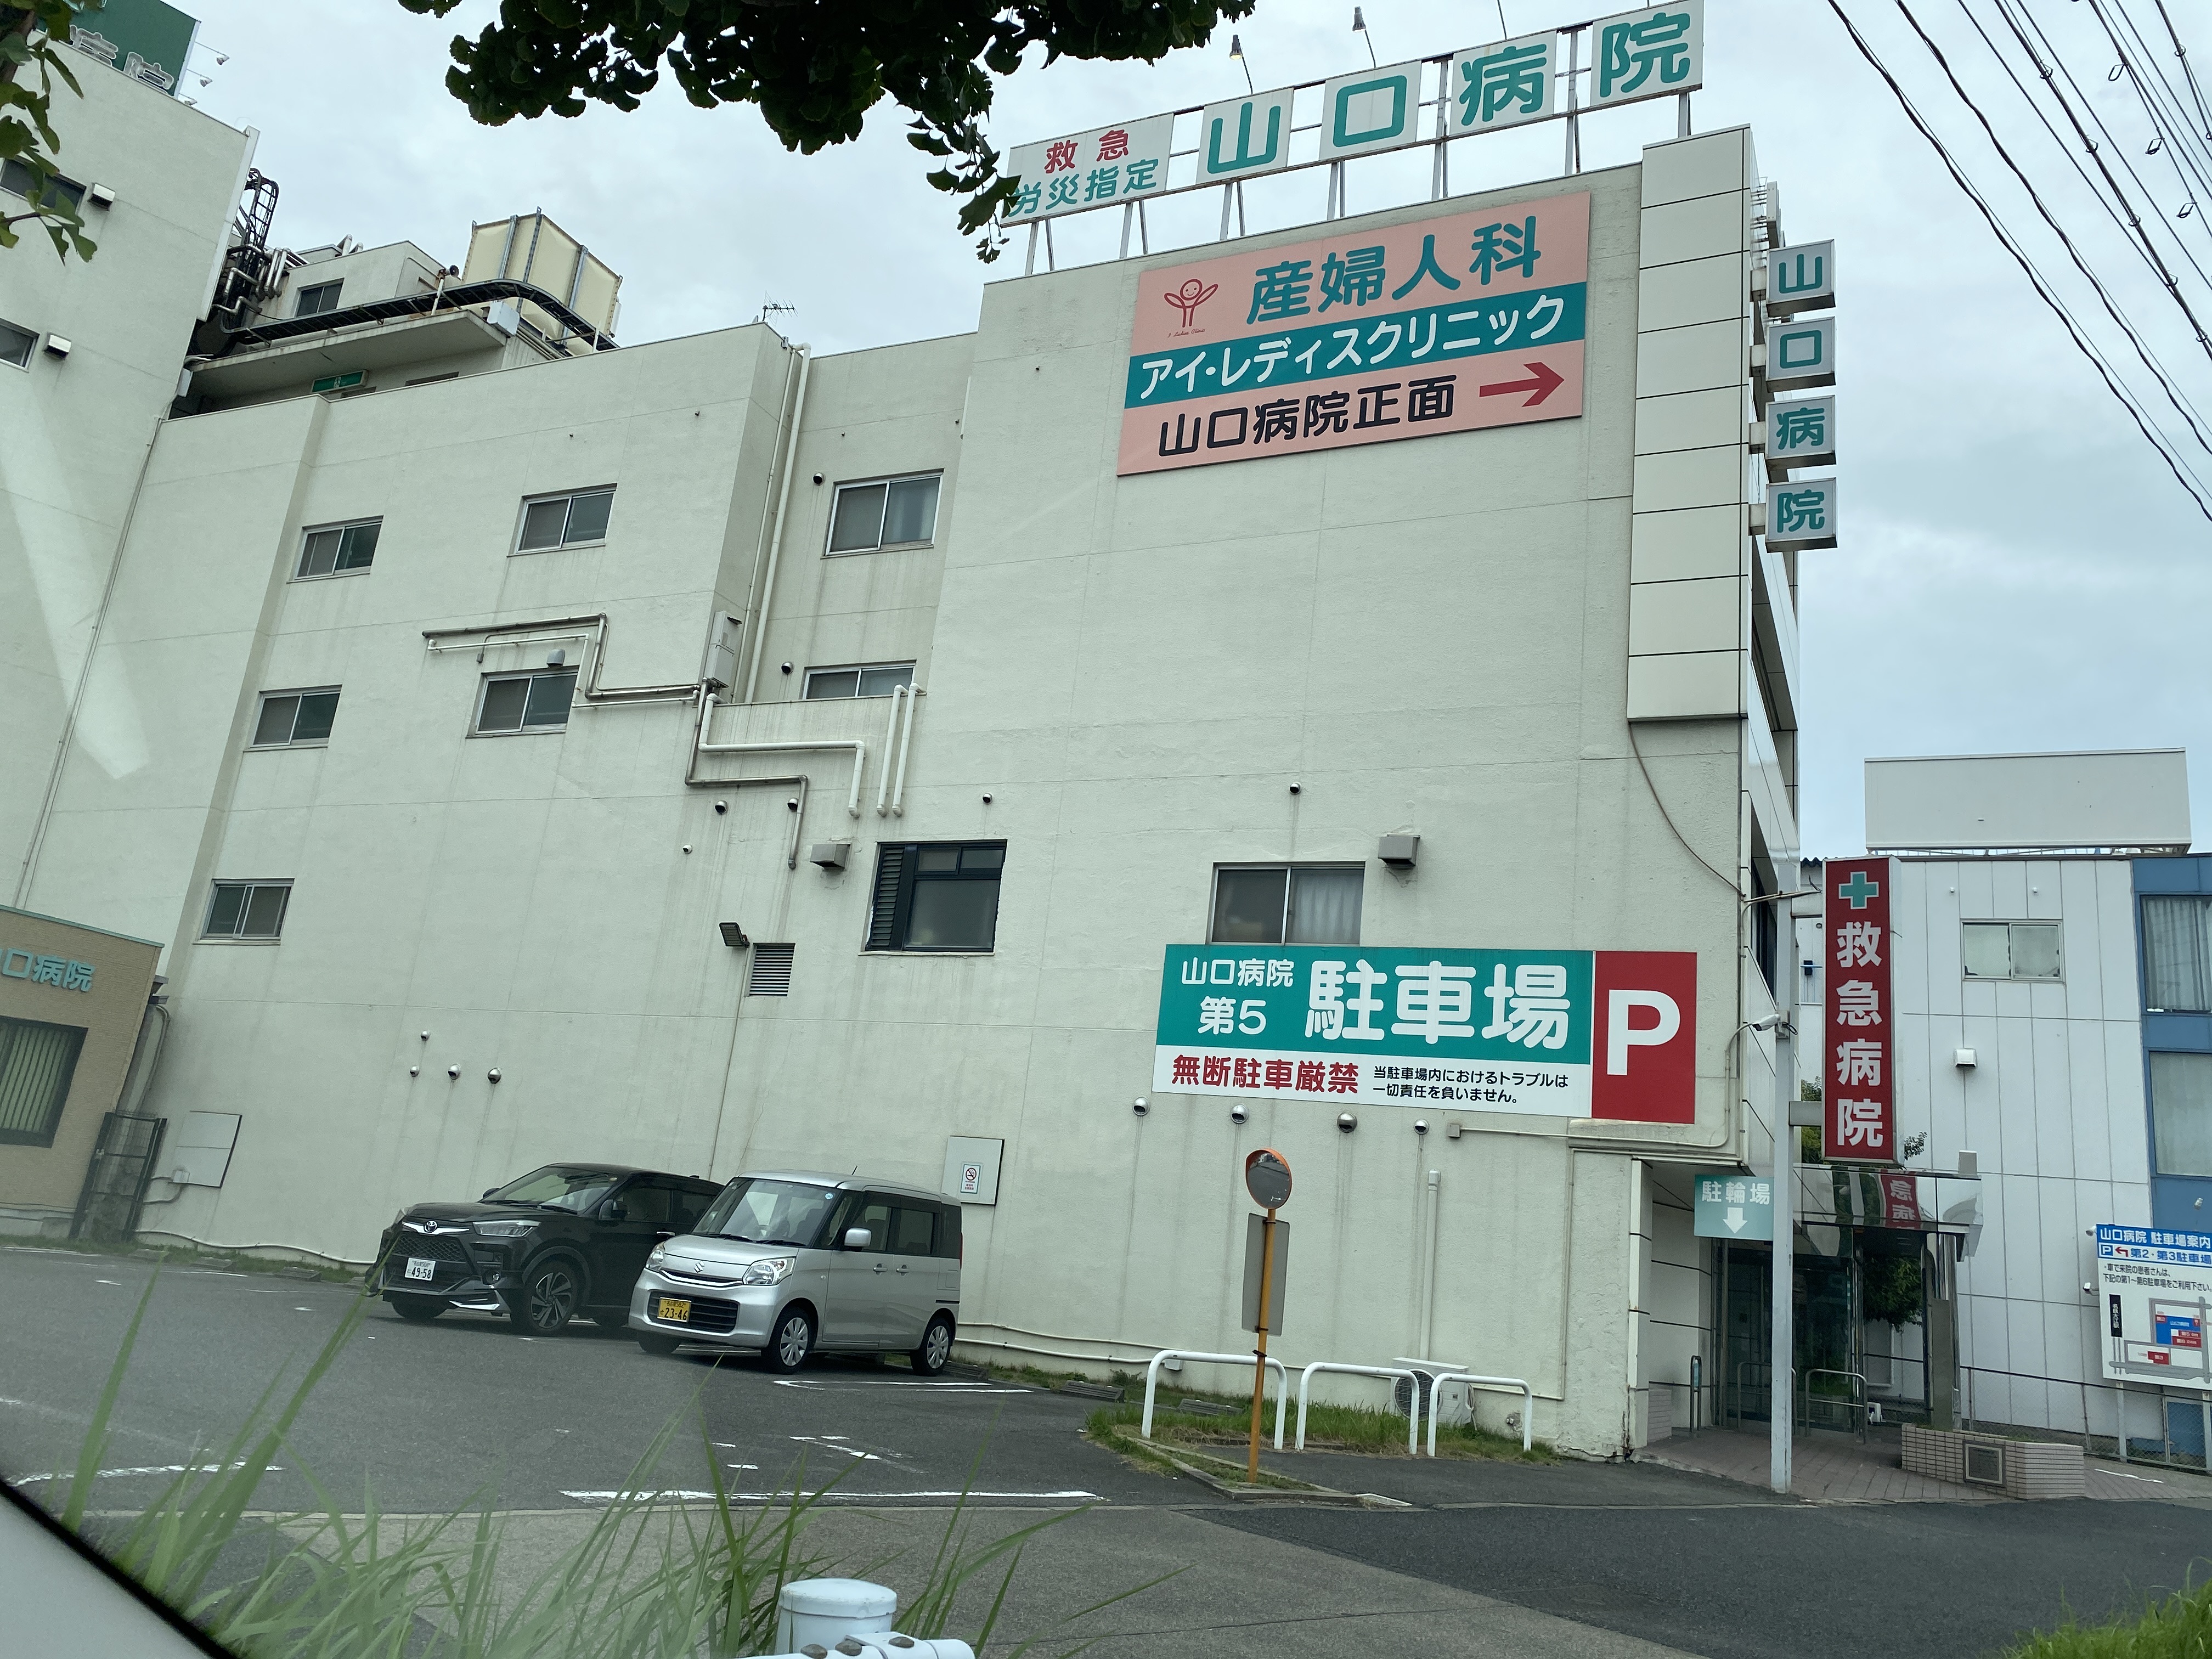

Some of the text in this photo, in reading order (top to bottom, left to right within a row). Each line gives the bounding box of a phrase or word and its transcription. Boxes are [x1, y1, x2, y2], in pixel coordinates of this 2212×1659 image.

[1207, 12, 1690, 174] 山口病院
[1044, 129, 1129, 174] 救急
[1008, 159, 1159, 218] 労災指定
[1246, 216, 1542, 325] 産婦人科
[1140, 295, 1565, 399] アイ・レディスクリニック
[1776, 253, 1825, 533] 山口病院
[1159, 375, 1457, 457] 山口病院正面
[0, 948, 95, 992] 口病院
[1181, 957, 1294, 987] 山口病院
[1198, 996, 1266, 1035] 第5
[1305, 958, 1571, 1051] 駐車場
[1607, 989, 1680, 1076] P
[1836, 921, 1883, 1147] 救急病院
[1172, 1054, 1359, 1093] 無断駐車厳禁
[1373, 1084, 1517, 1104] 一切責任を負いません。
[1374, 1065, 1568, 1088] 当駐車場内におけるトラブルは
[1702, 1181, 1770, 1205] 駐輪場
[2100, 1227, 2211, 1249] 山口病院 駐車場案内
[2102, 1246, 2112, 1254] P
[411, 1267, 432, 1279] 49-58
[664, 1307, 688, 1320] 23-46
